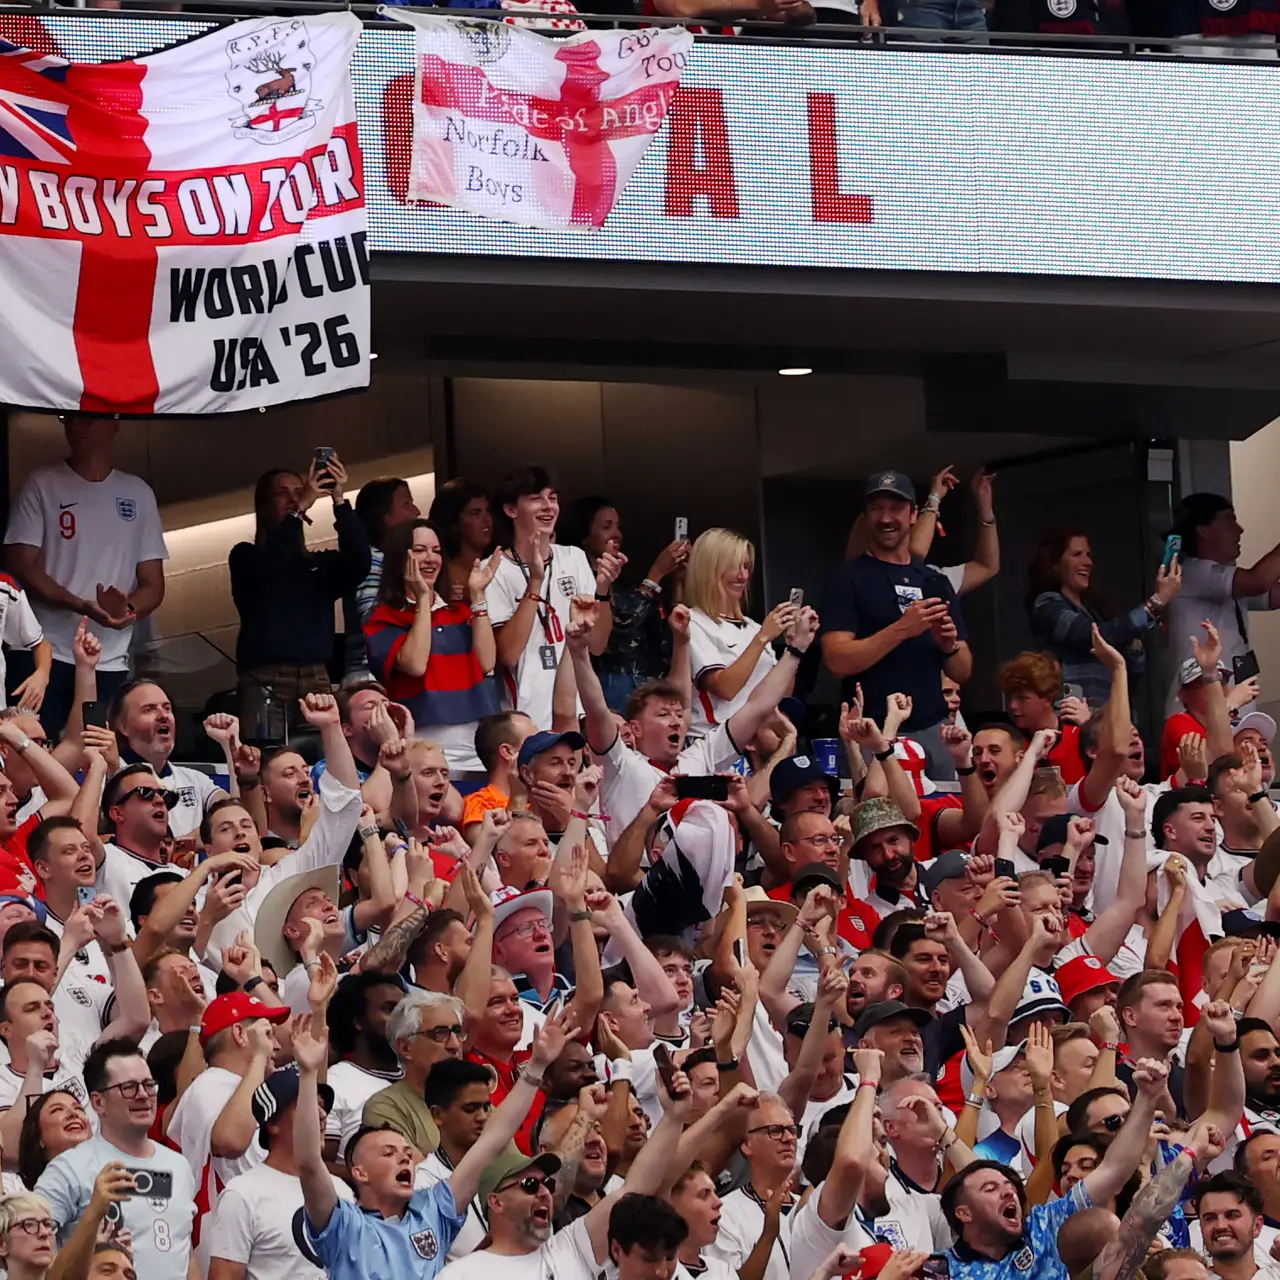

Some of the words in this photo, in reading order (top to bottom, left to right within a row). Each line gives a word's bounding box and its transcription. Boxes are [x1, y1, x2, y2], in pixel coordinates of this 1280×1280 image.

[478, 78, 549, 129] Pide
[443, 116, 550, 162] Norfolk
[28, 171, 173, 239] BOYS
[178, 172, 252, 237] ON
[258, 136, 361, 233] TOR
[465, 165, 523, 206] Boys
[280, 314, 362, 376] '26
[60, 511, 76, 540] 9
[153, 1219, 171, 1252] 8
